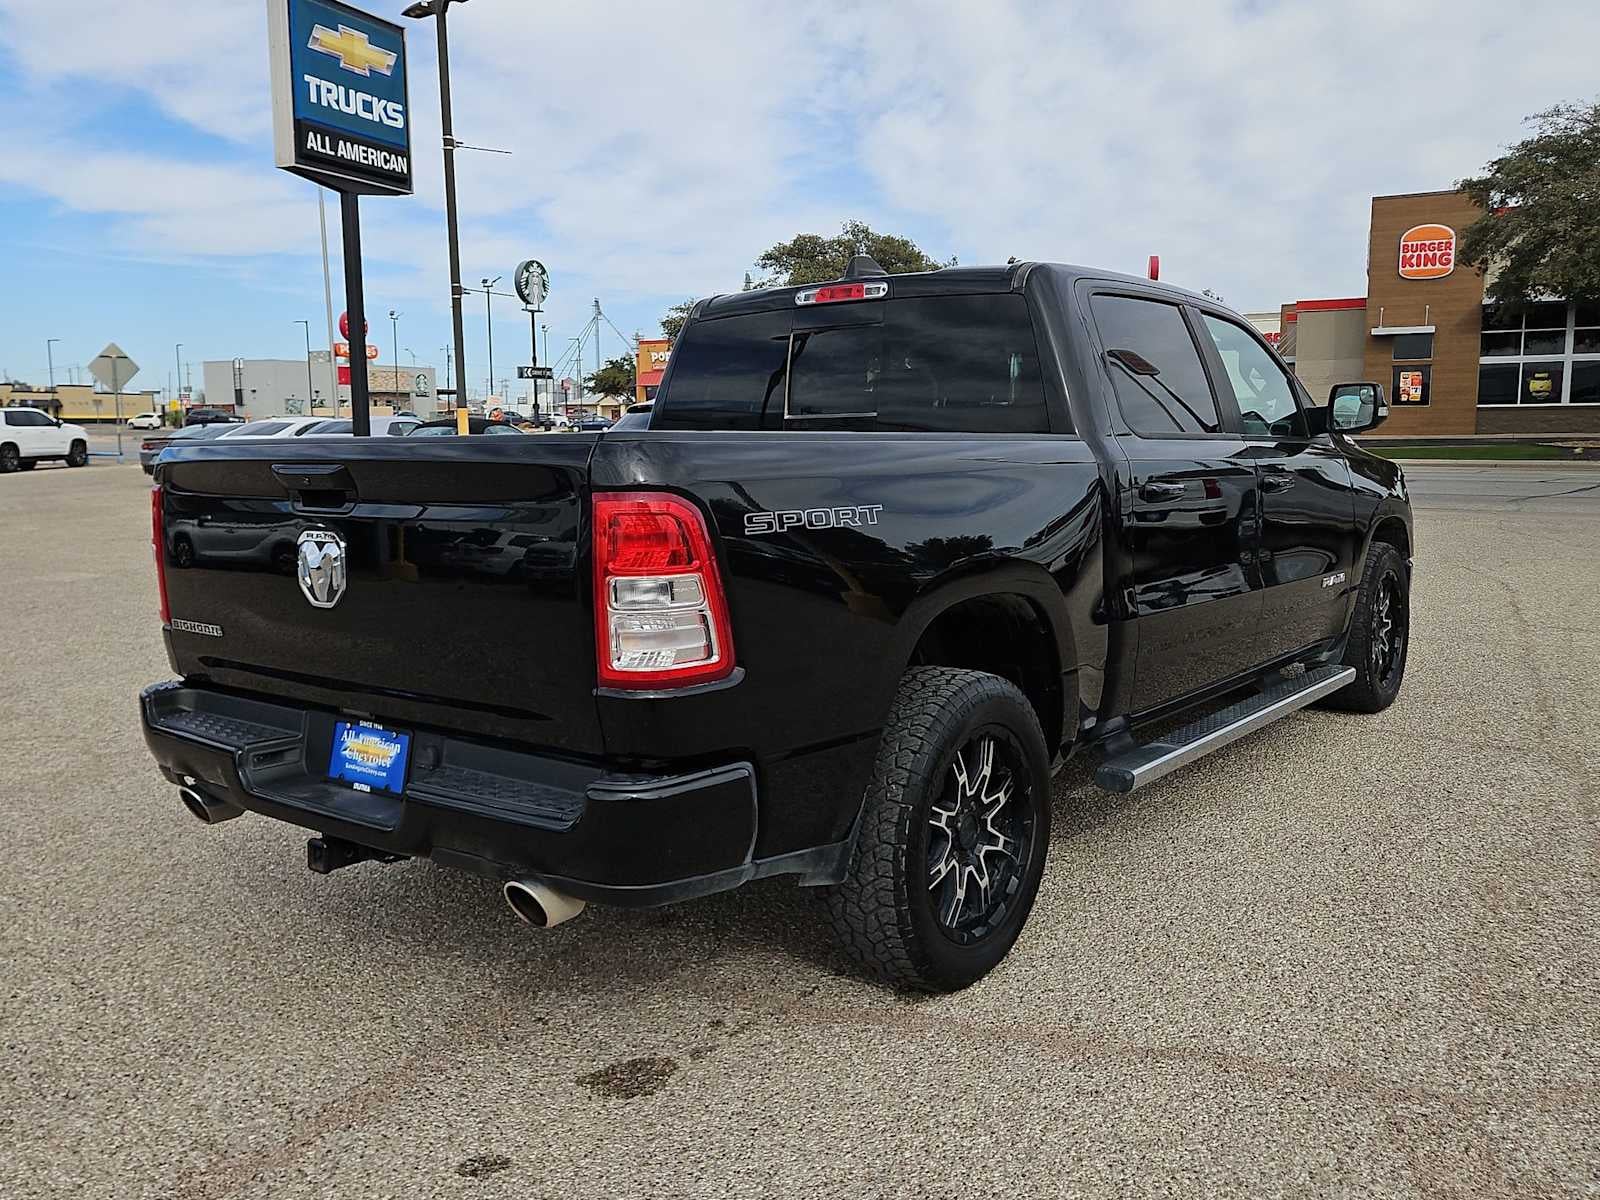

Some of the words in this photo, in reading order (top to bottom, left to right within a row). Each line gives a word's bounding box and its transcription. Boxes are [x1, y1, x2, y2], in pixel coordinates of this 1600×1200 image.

[303, 74, 404, 129] TRUCKS
[306, 131, 335, 156] ALL
[337, 139, 408, 174] AMERICAN
[1402, 241, 1453, 254] BURGER
[1401, 252, 1452, 269] KING
[744, 504, 883, 536] SPORT
[305, 532, 337, 541] RAM
[341, 729, 356, 742] All
[358, 732, 401, 754] American
[345, 746, 393, 768] Chevrolet
